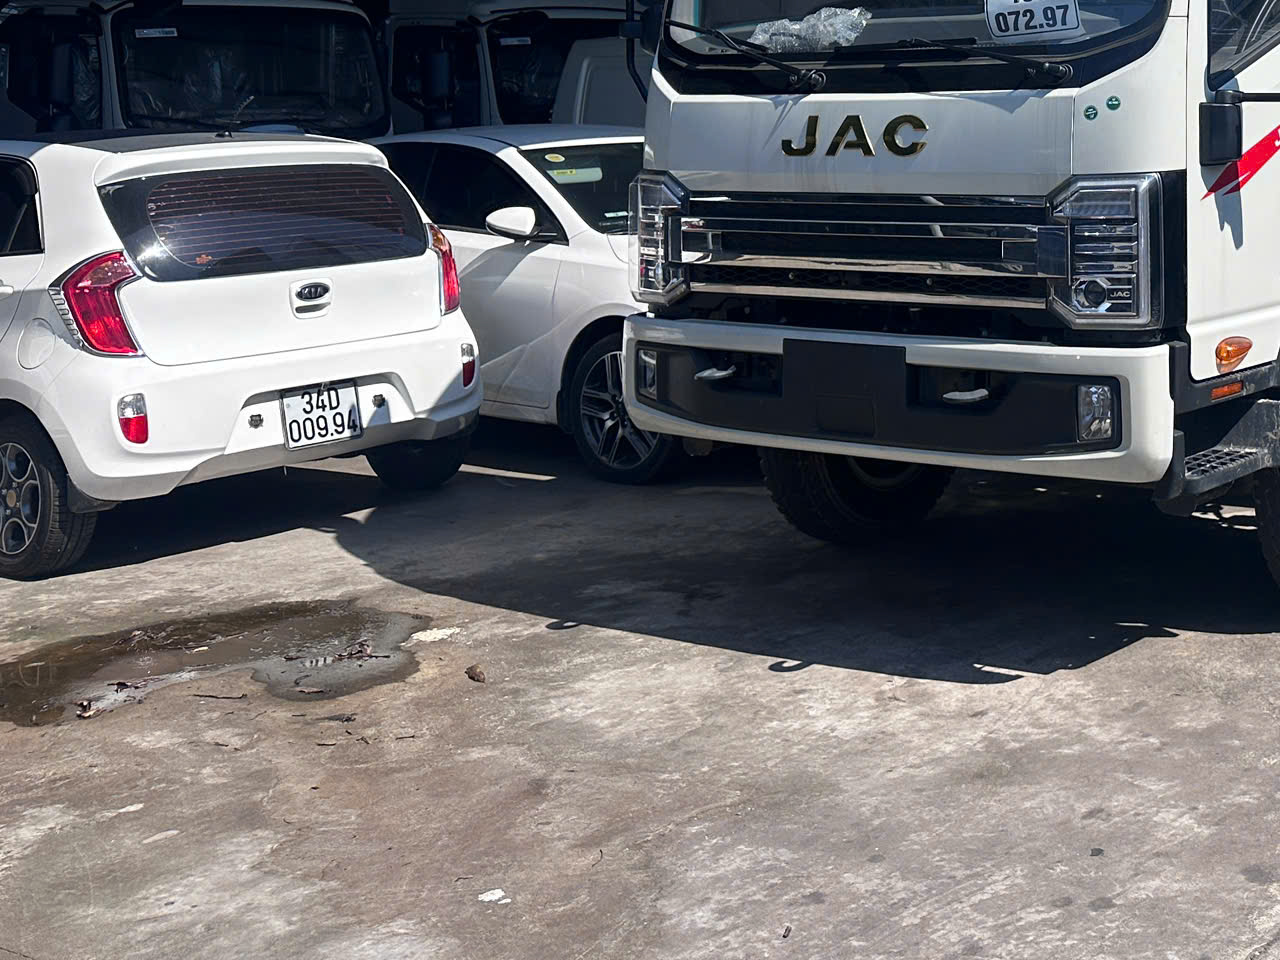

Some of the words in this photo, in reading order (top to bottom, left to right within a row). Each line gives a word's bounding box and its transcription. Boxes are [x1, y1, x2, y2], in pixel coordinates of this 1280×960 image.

[994, 4, 1070, 33] 072.97
[781, 114, 929, 157] JAC
[301, 387, 341, 414] 34D
[288, 409, 359, 443] 009.94
